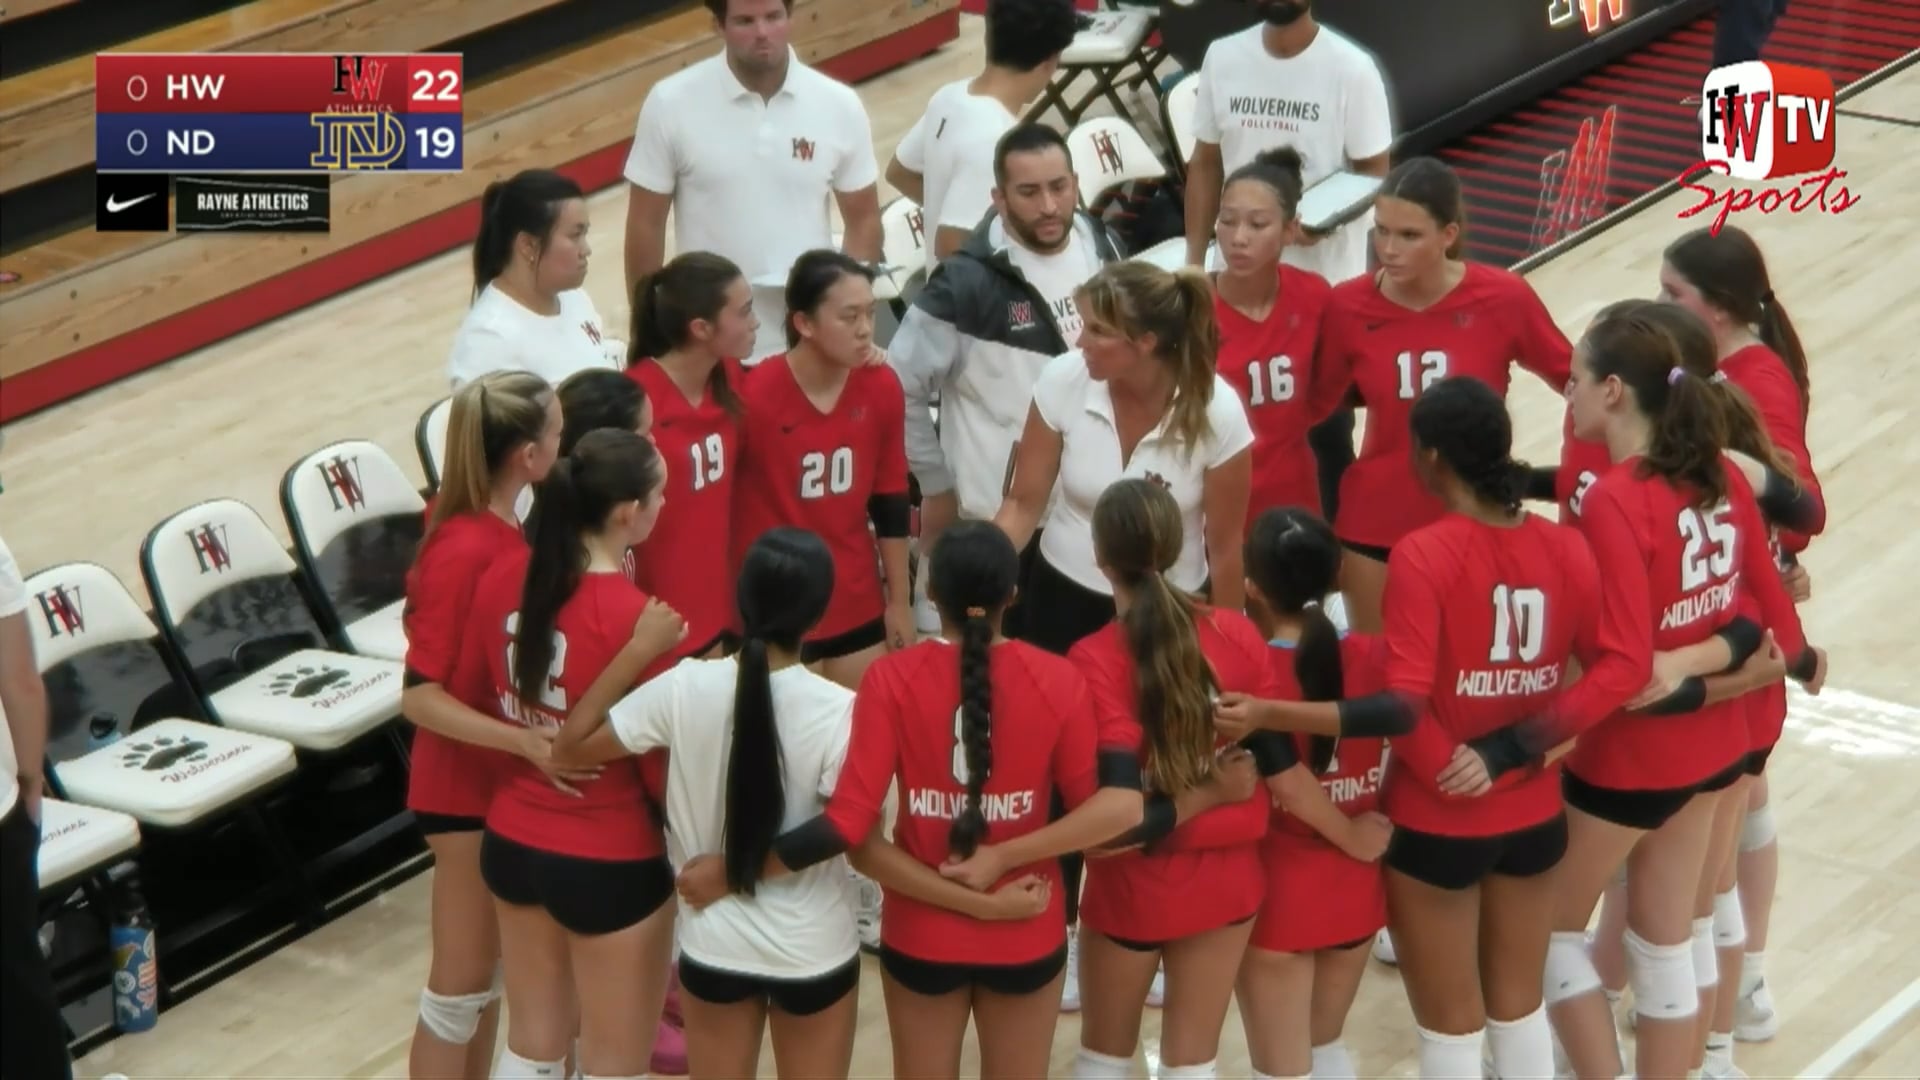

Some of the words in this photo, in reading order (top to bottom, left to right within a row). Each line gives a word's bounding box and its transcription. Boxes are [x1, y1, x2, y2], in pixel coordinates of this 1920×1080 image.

[1229, 96, 1321, 121] WOLVERINES
[1240, 118, 1300, 133] VOLLEYBALL
[1248, 355, 1294, 405] 16
[1396, 351, 1447, 399] 12
[691, 432, 724, 490] 19
[801, 447, 853, 499] 20
[1678, 502, 1736, 592] 25
[1489, 584, 1545, 662] 10
